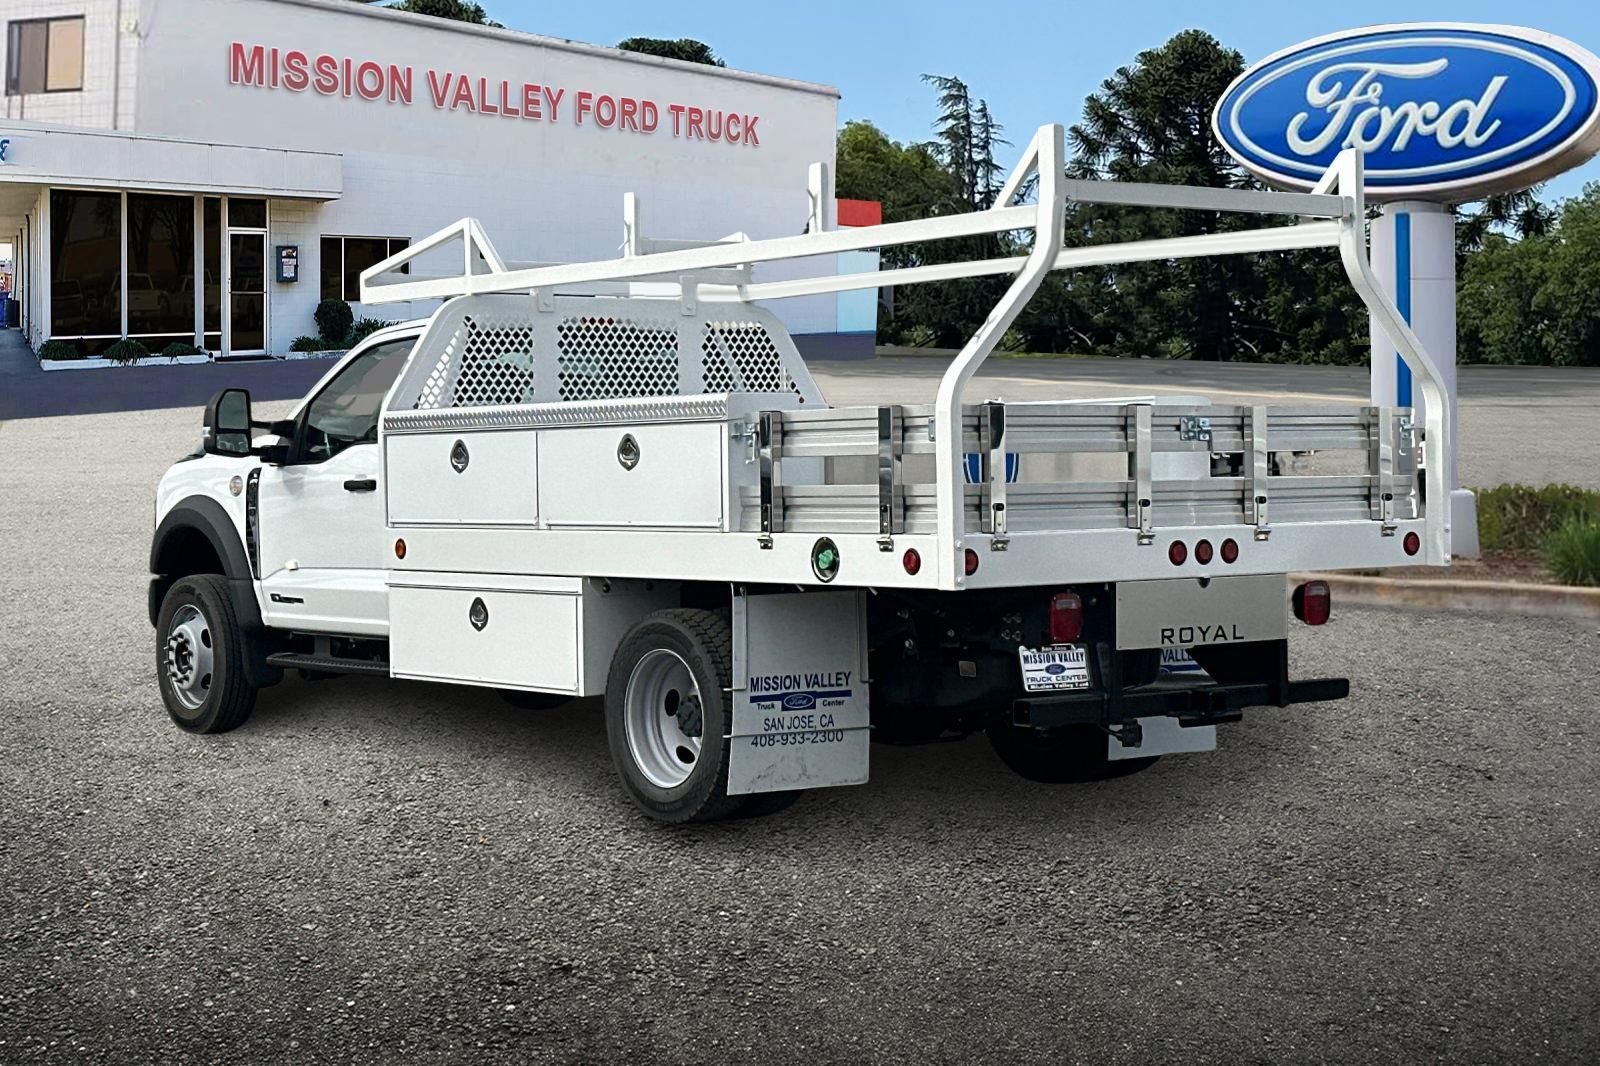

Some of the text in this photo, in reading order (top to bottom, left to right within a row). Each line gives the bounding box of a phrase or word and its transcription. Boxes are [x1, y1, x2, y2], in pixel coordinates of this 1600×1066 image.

[229, 41, 761, 146] MISSION VALLEY FORD TRUCK
[1286, 58, 1509, 156] Ford
[1161, 624, 1245, 645] ROYAL
[1023, 652, 1084, 665] MISSION VALLEY
[1160, 648, 1194, 663] VALL
[750, 671, 852, 693] MISSION VALLEY
[1026, 674, 1088, 684] TRUCK CENTER
[763, 714, 835, 732] SAN JOSE, CA
[751, 729, 844, 748] 408-933-2300
